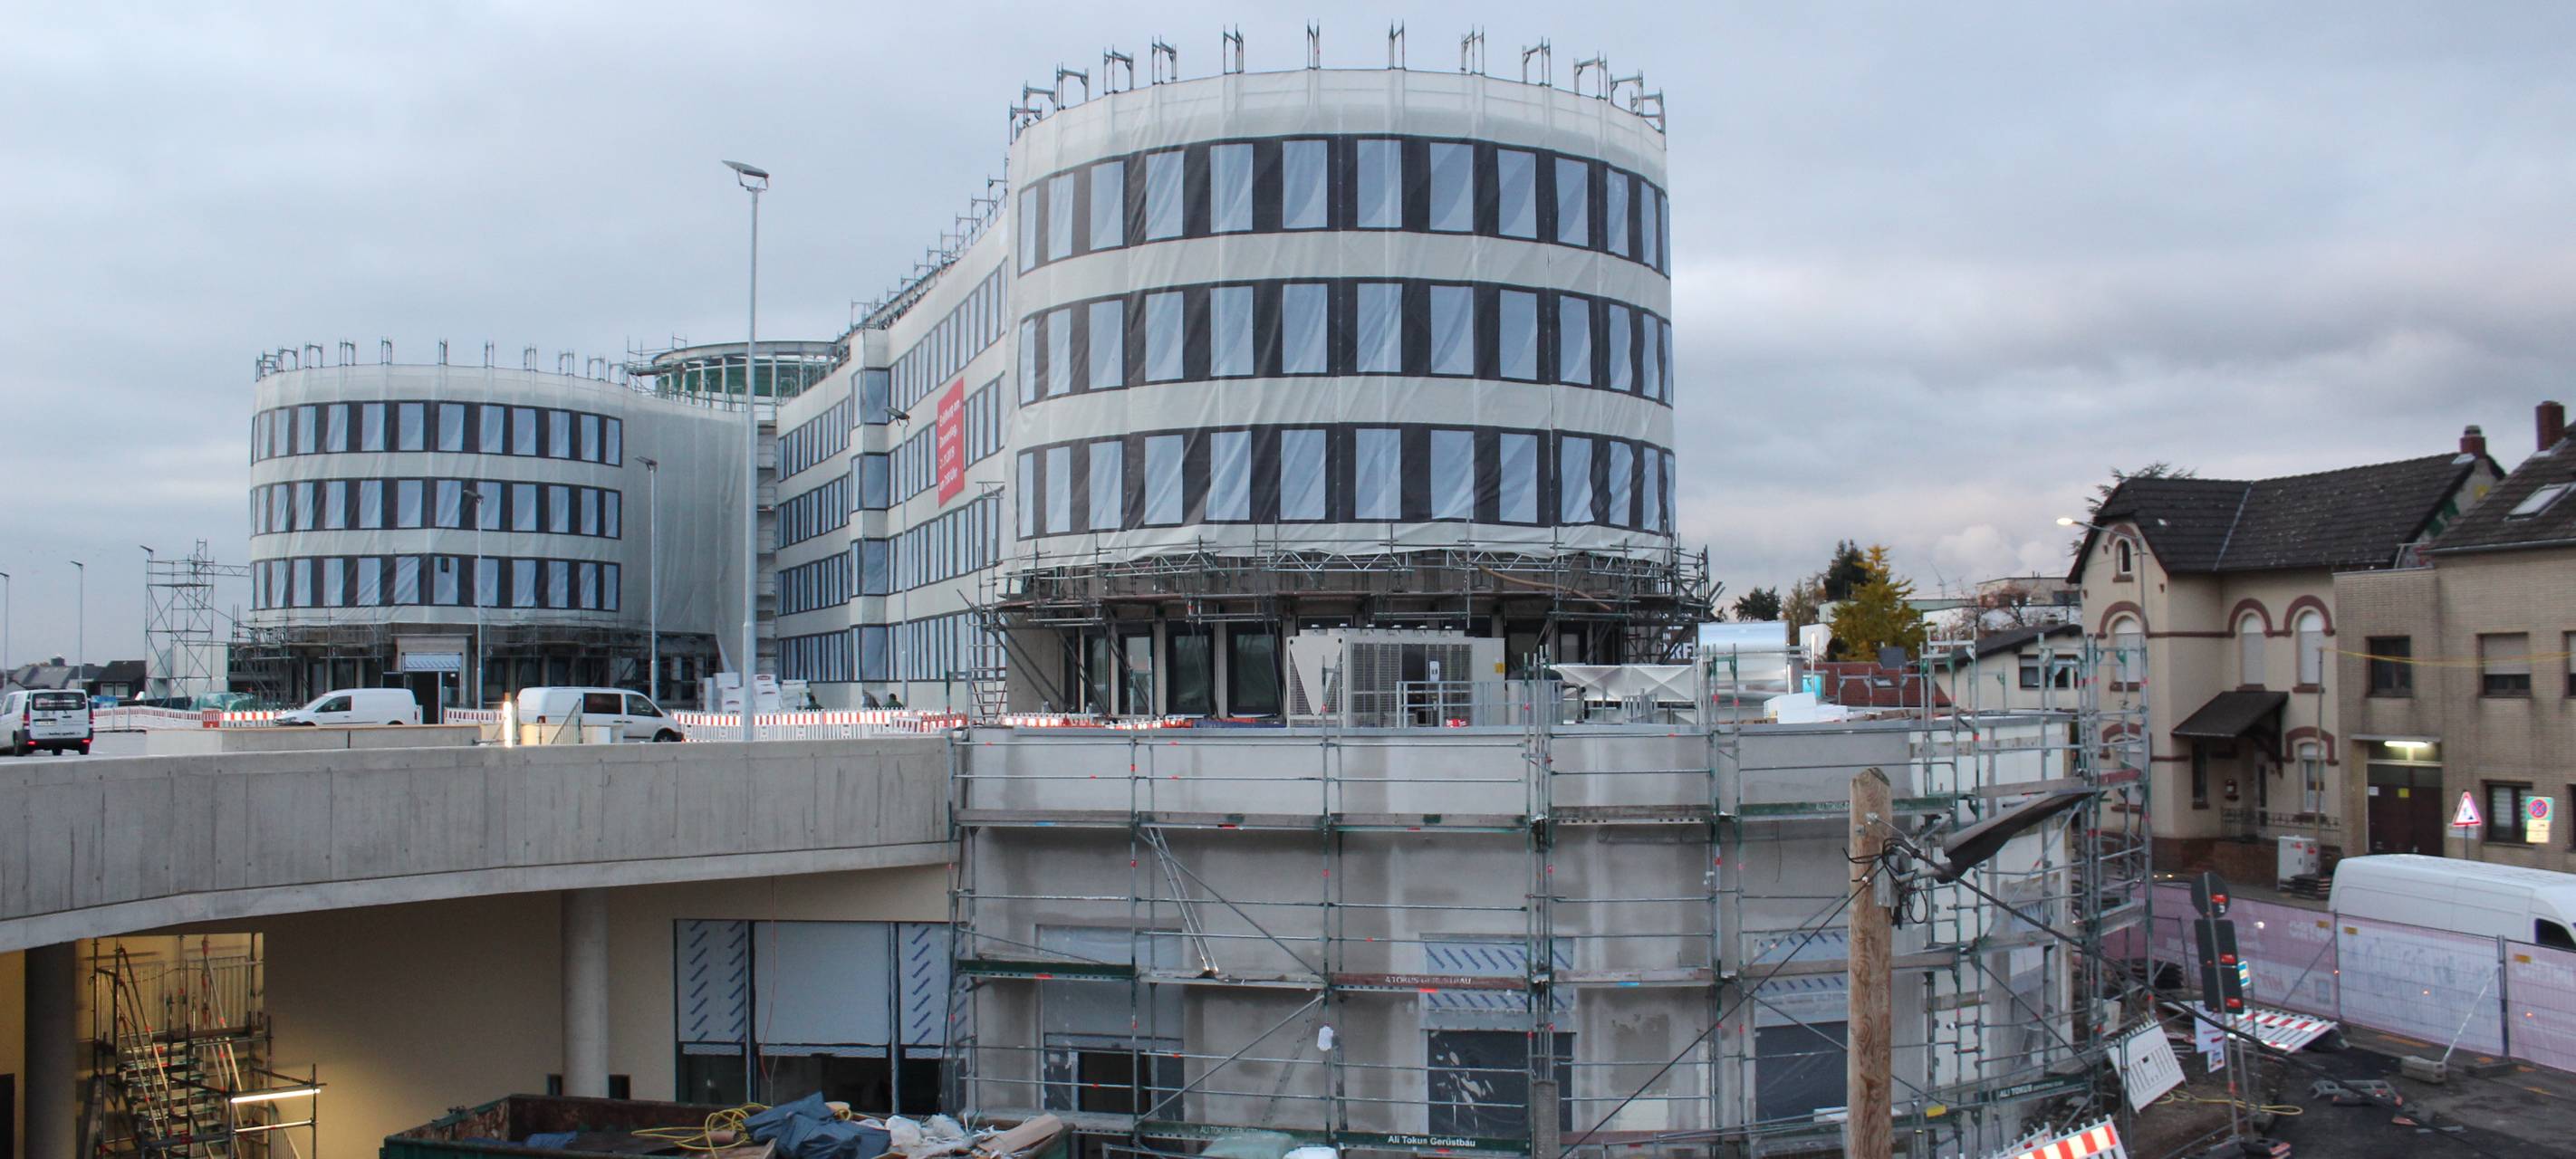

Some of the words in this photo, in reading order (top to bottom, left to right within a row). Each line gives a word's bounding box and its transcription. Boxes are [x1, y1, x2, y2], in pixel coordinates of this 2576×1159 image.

[1388, 1135, 1399, 1144] Ali
[1401, 1135, 1427, 1145] Tokus
[1429, 1137, 1475, 1148] Gerüstbau
